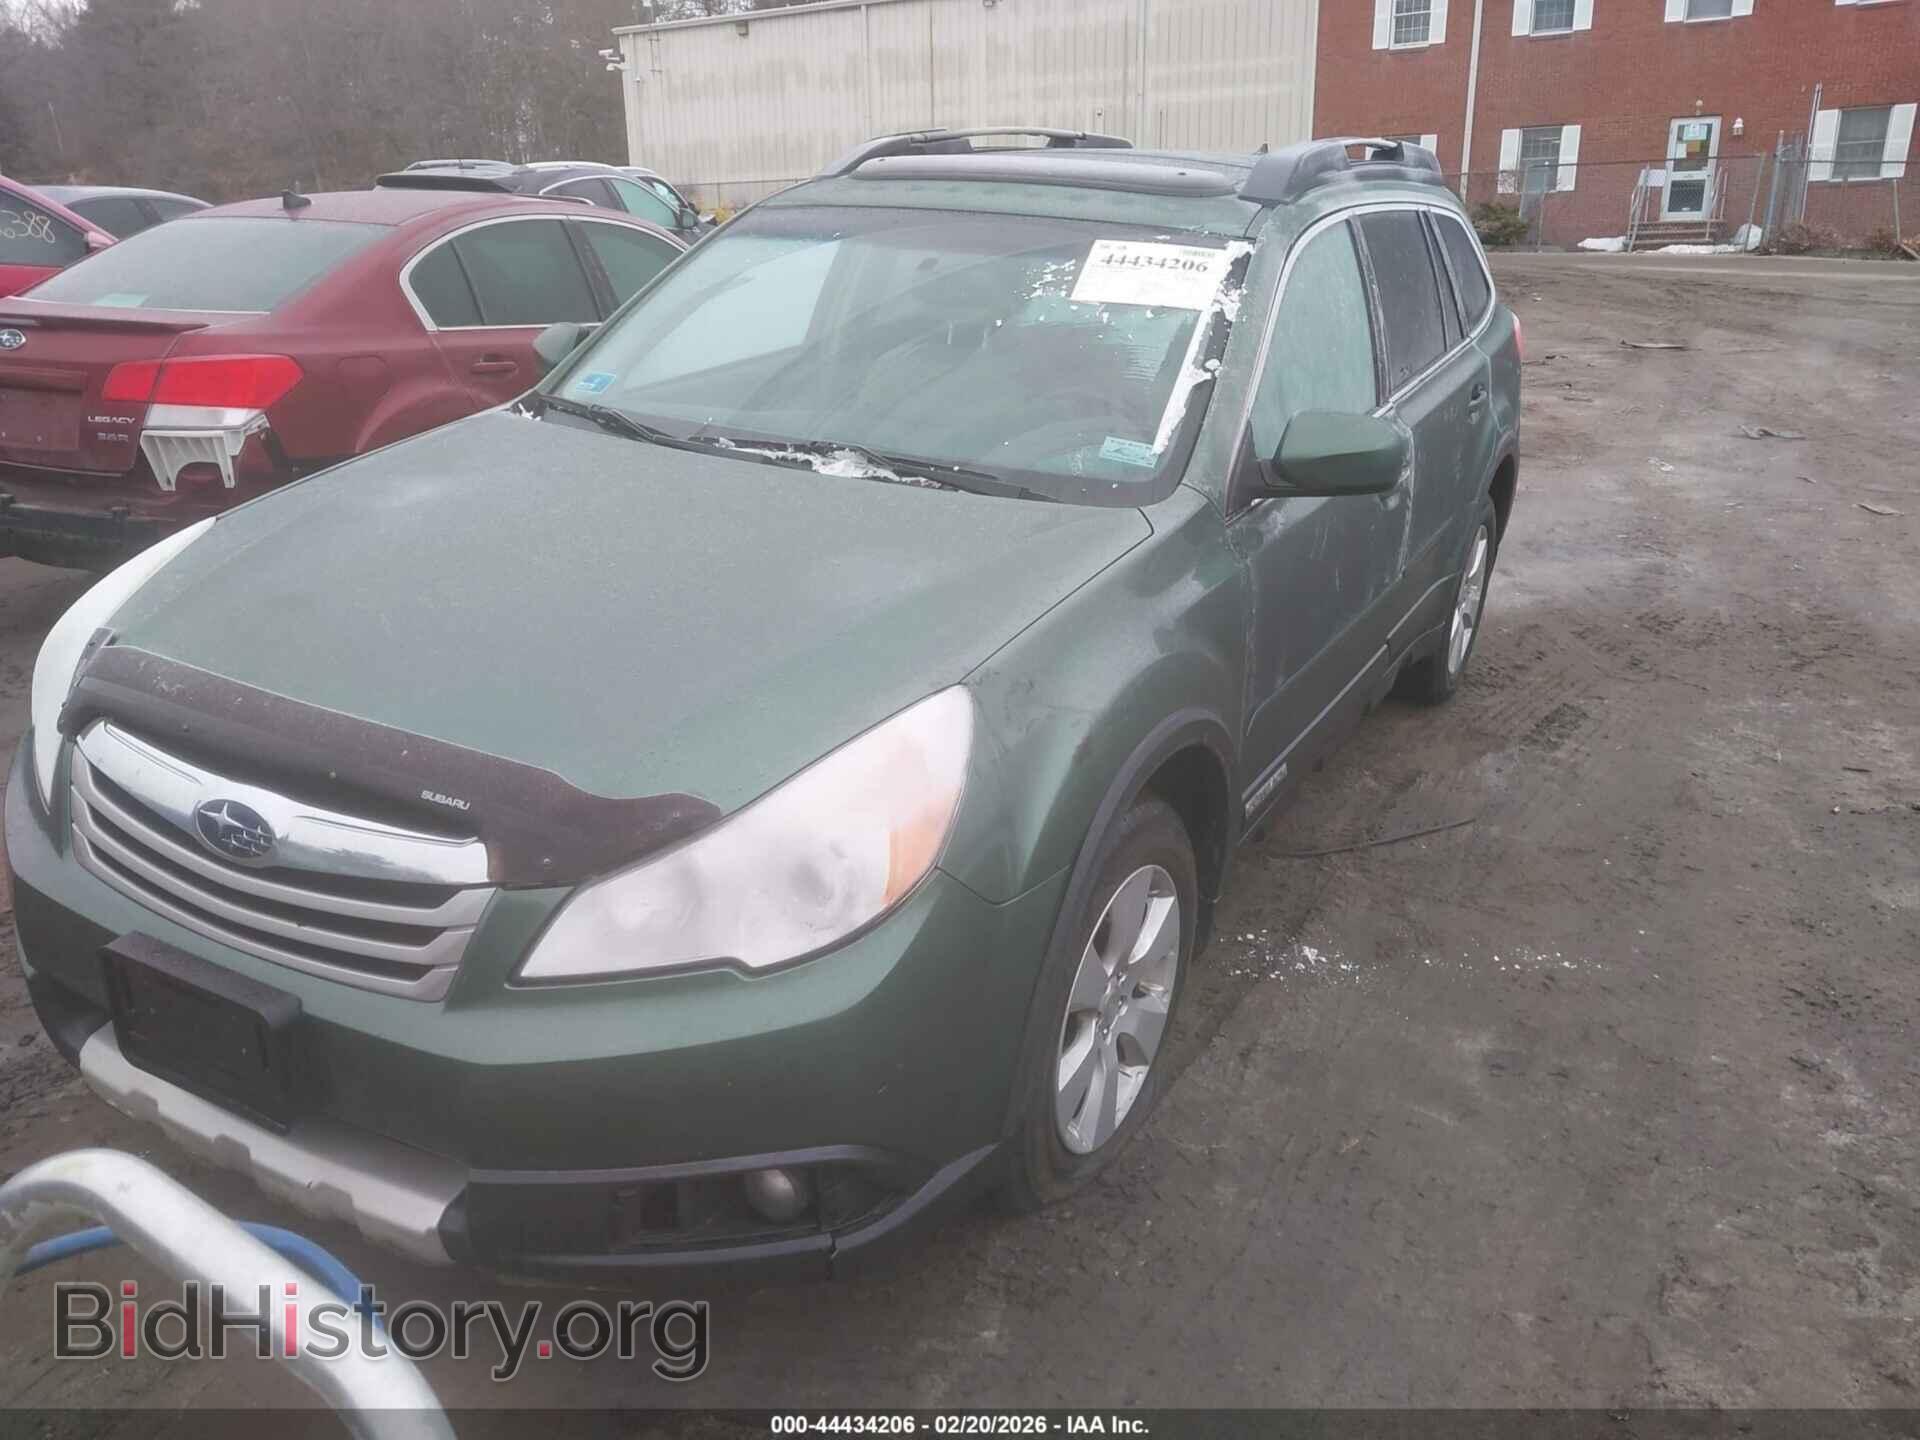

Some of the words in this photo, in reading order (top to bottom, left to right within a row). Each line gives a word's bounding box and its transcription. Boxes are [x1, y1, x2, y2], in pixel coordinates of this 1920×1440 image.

[1100, 252, 1209, 273] 44434206
[87, 415, 136, 424] LEGACY
[420, 790, 470, 810] SUBARU
